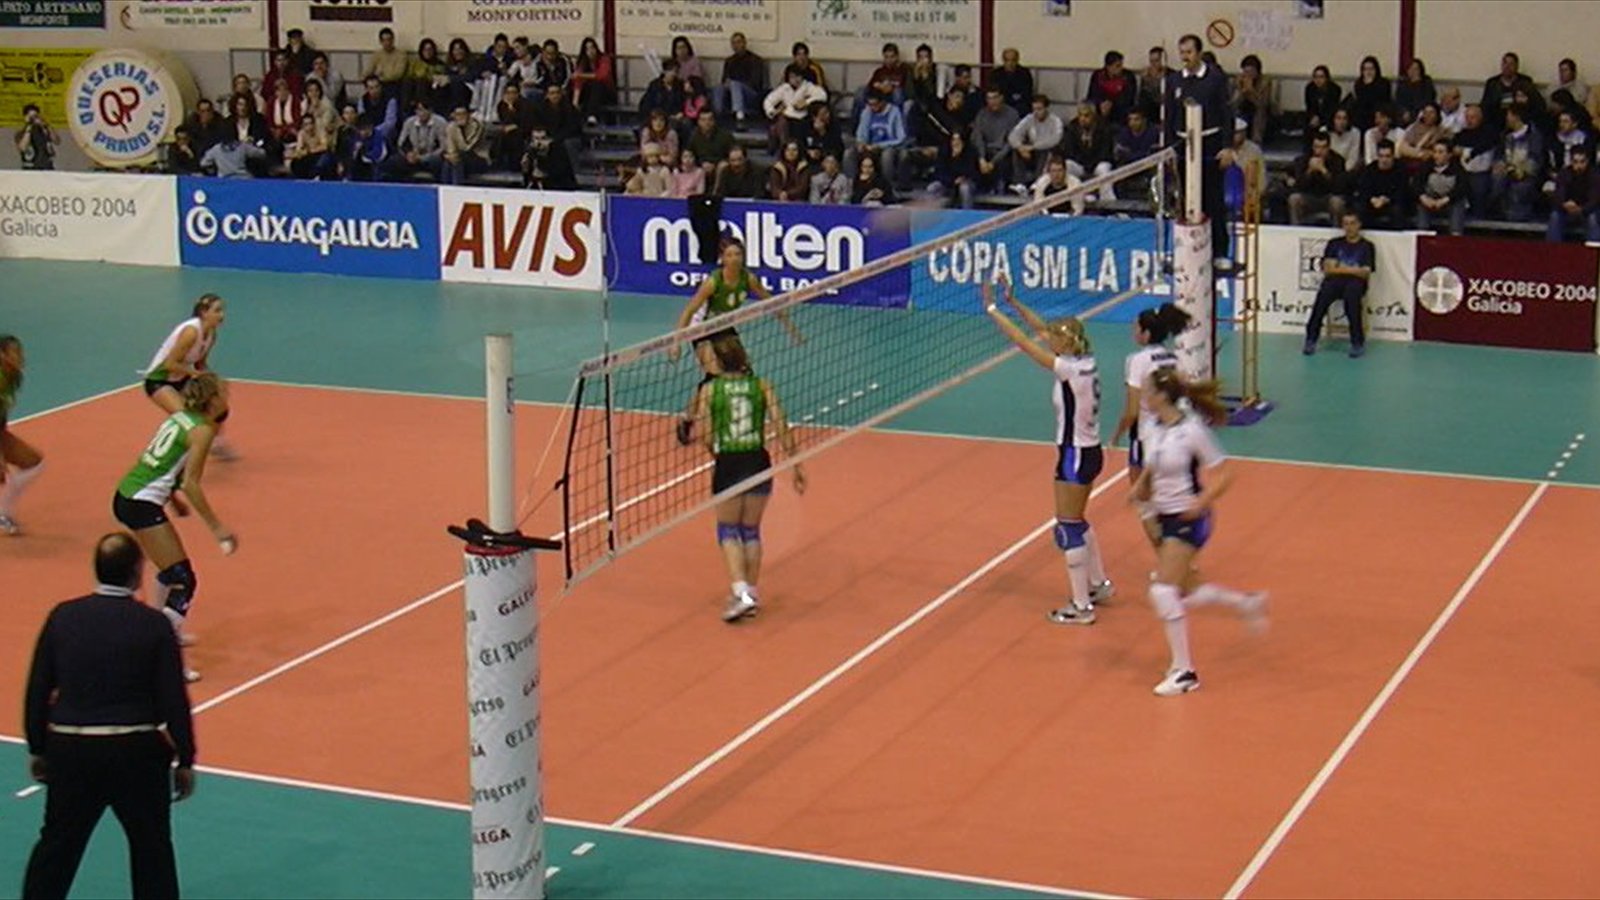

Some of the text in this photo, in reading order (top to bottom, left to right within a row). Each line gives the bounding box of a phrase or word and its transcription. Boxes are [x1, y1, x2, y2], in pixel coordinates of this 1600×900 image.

[467, 9, 583, 22] MONFORTINO
[77, 61, 160, 126] QUESERIAS
[93, 130, 150, 152] PRADO
[0, 196, 137, 217] XACOBEO 2004
[1, 218, 59, 238] Galicia
[442, 202, 592, 277] AVIS
[642, 210, 865, 272] mlten
[928, 241, 1013, 288] COPA
[1022, 243, 1068, 290] SM
[1079, 246, 1119, 292] LA
[1467, 278, 1597, 302] XACOBEO 2004
[1466, 296, 1523, 314] Galicia
